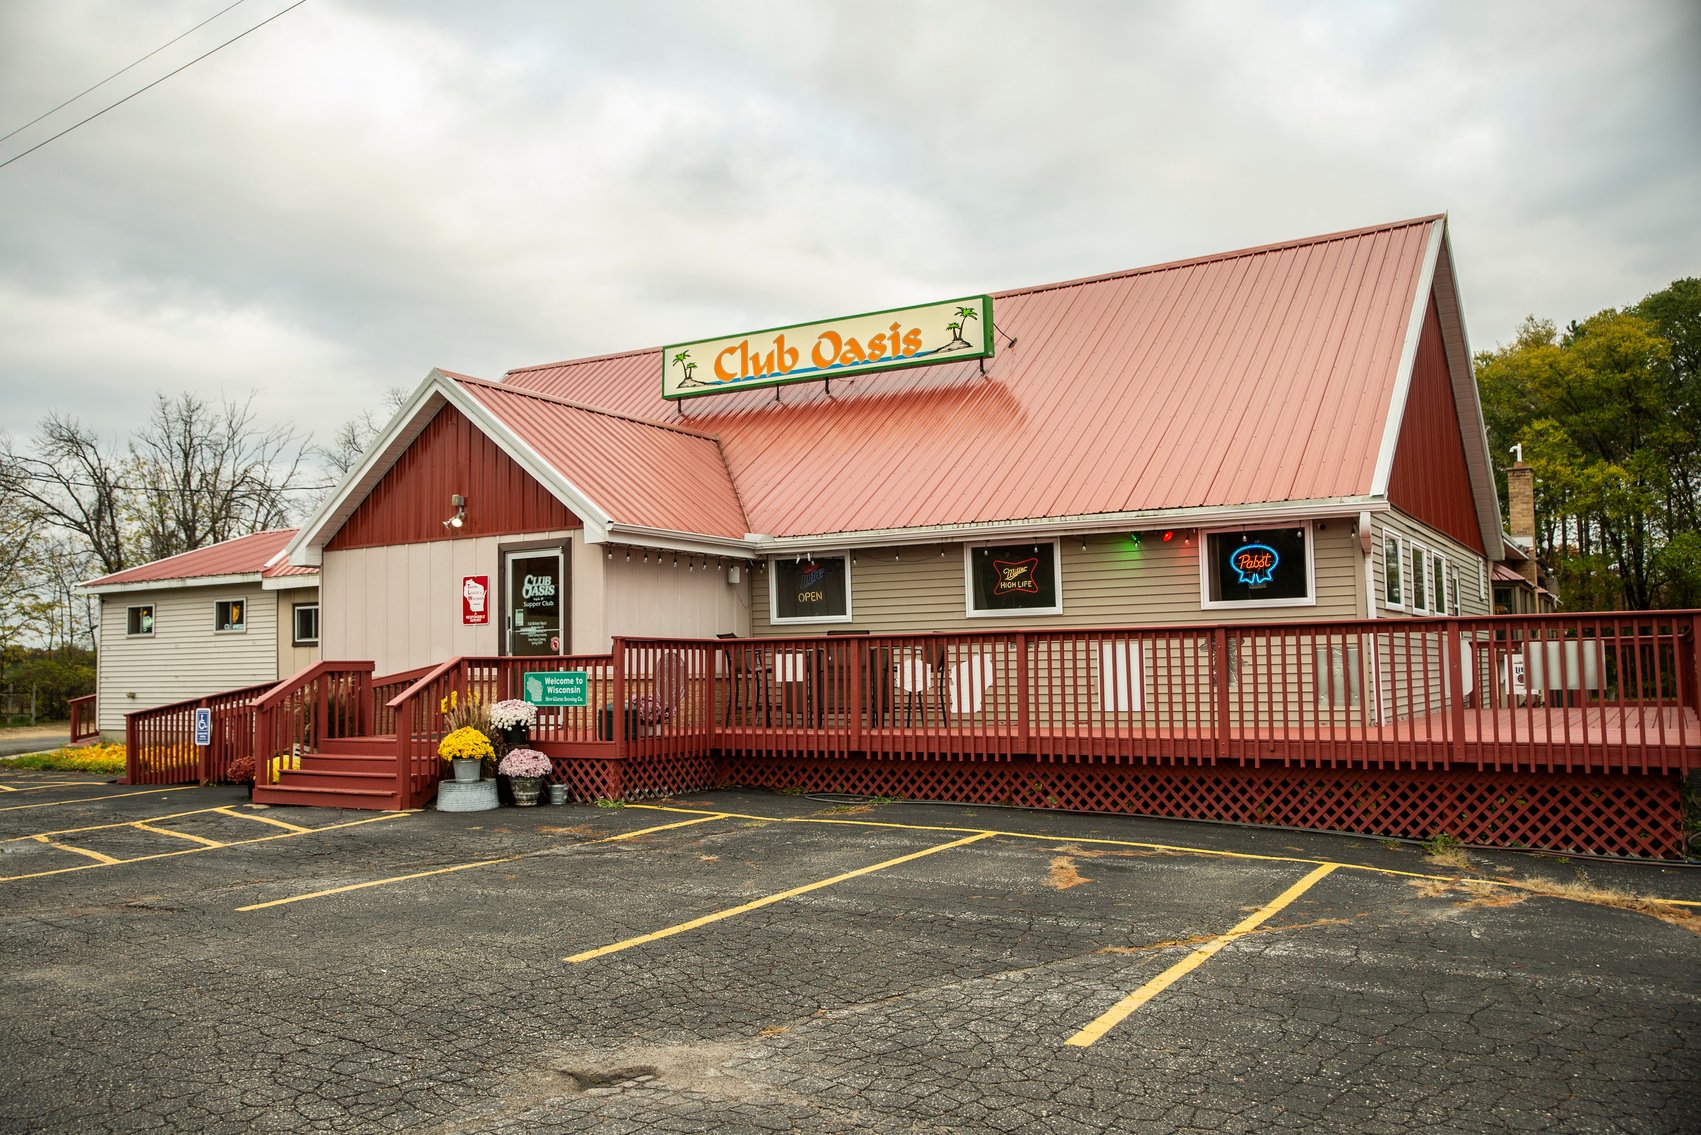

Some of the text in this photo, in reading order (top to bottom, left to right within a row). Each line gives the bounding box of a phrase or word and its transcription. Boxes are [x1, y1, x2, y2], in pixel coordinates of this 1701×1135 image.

[713, 321, 923, 383] Club Oasis
[1238, 552, 1271, 569] Pabst
[1002, 566, 1028, 581] Miller
[524, 574, 552, 587] CLUB
[1000, 580, 1033, 589] HIGH LIFE
[522, 583, 556, 599] OASIS
[798, 591, 823, 602] OPEN
[544, 676, 584, 685] Welcome to
[546, 686, 581, 694] Wisconsin
